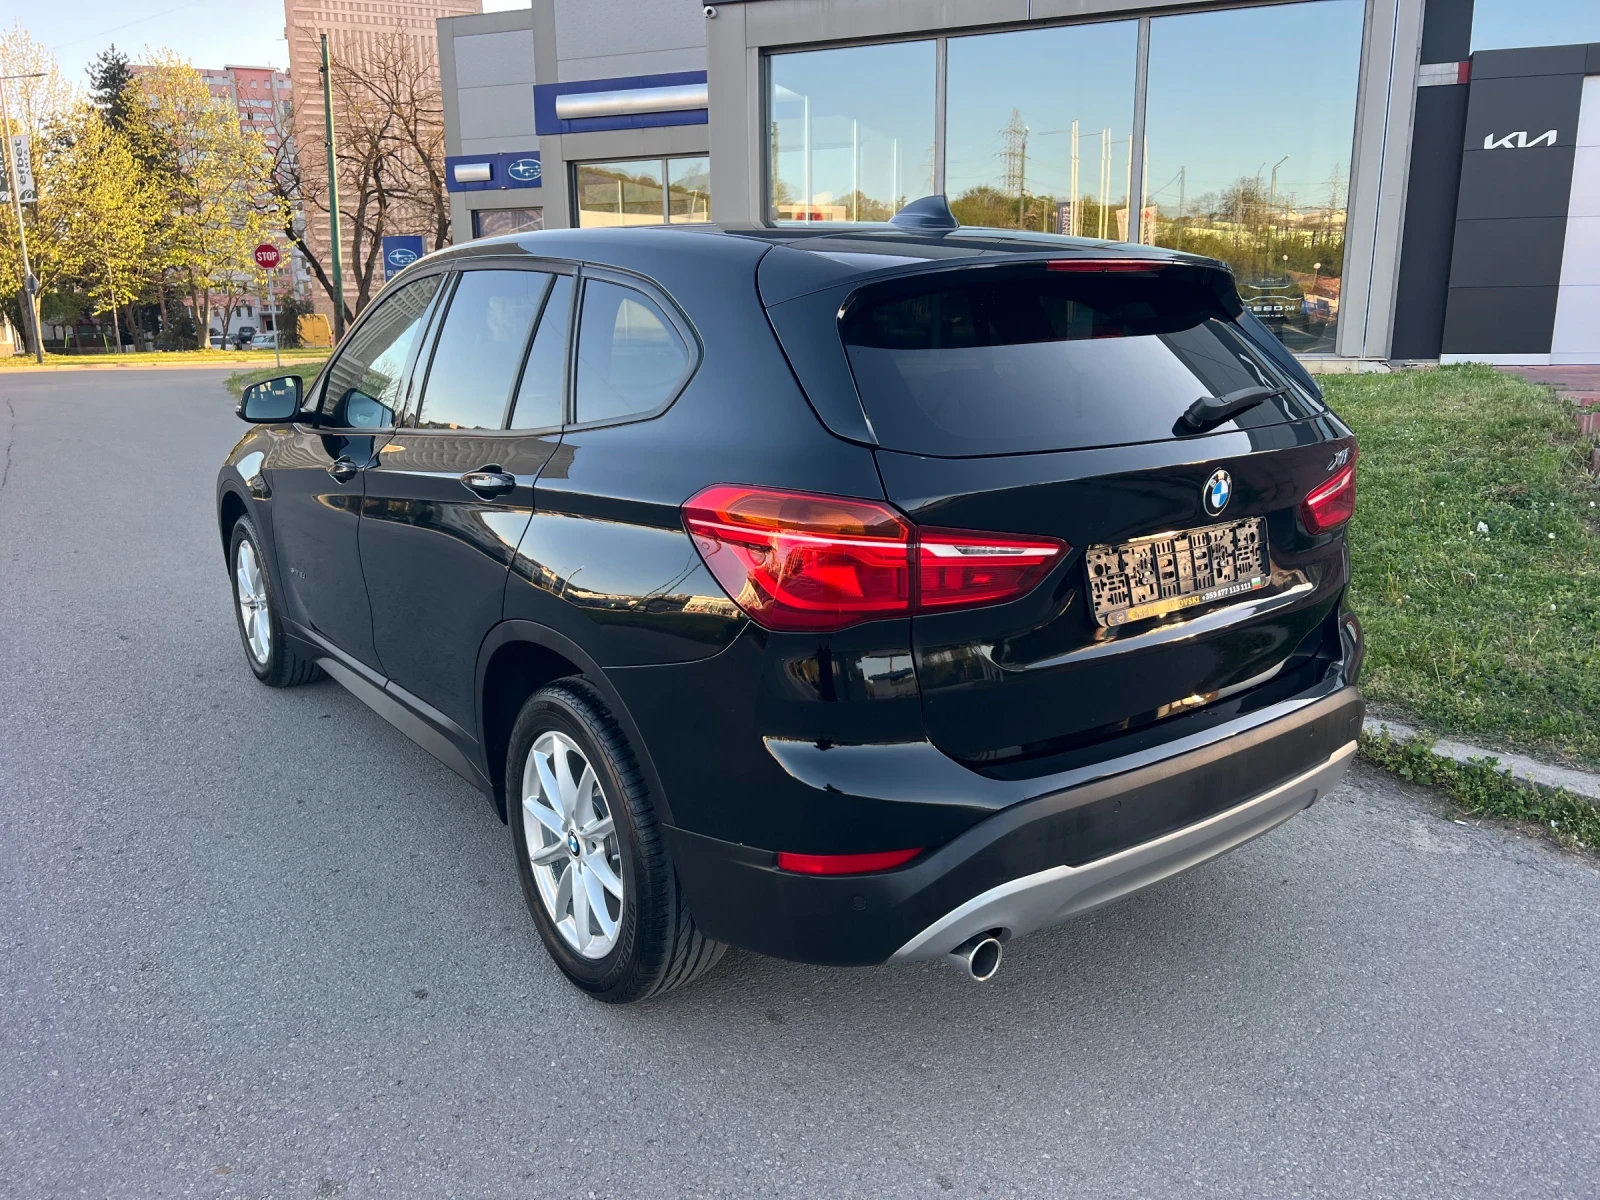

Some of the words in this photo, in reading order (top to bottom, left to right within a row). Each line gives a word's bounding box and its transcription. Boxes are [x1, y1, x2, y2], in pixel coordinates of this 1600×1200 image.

[1484, 129, 1558, 150] KIA
[14, 138, 27, 186] efbet
[256, 251, 278, 262] STOP
